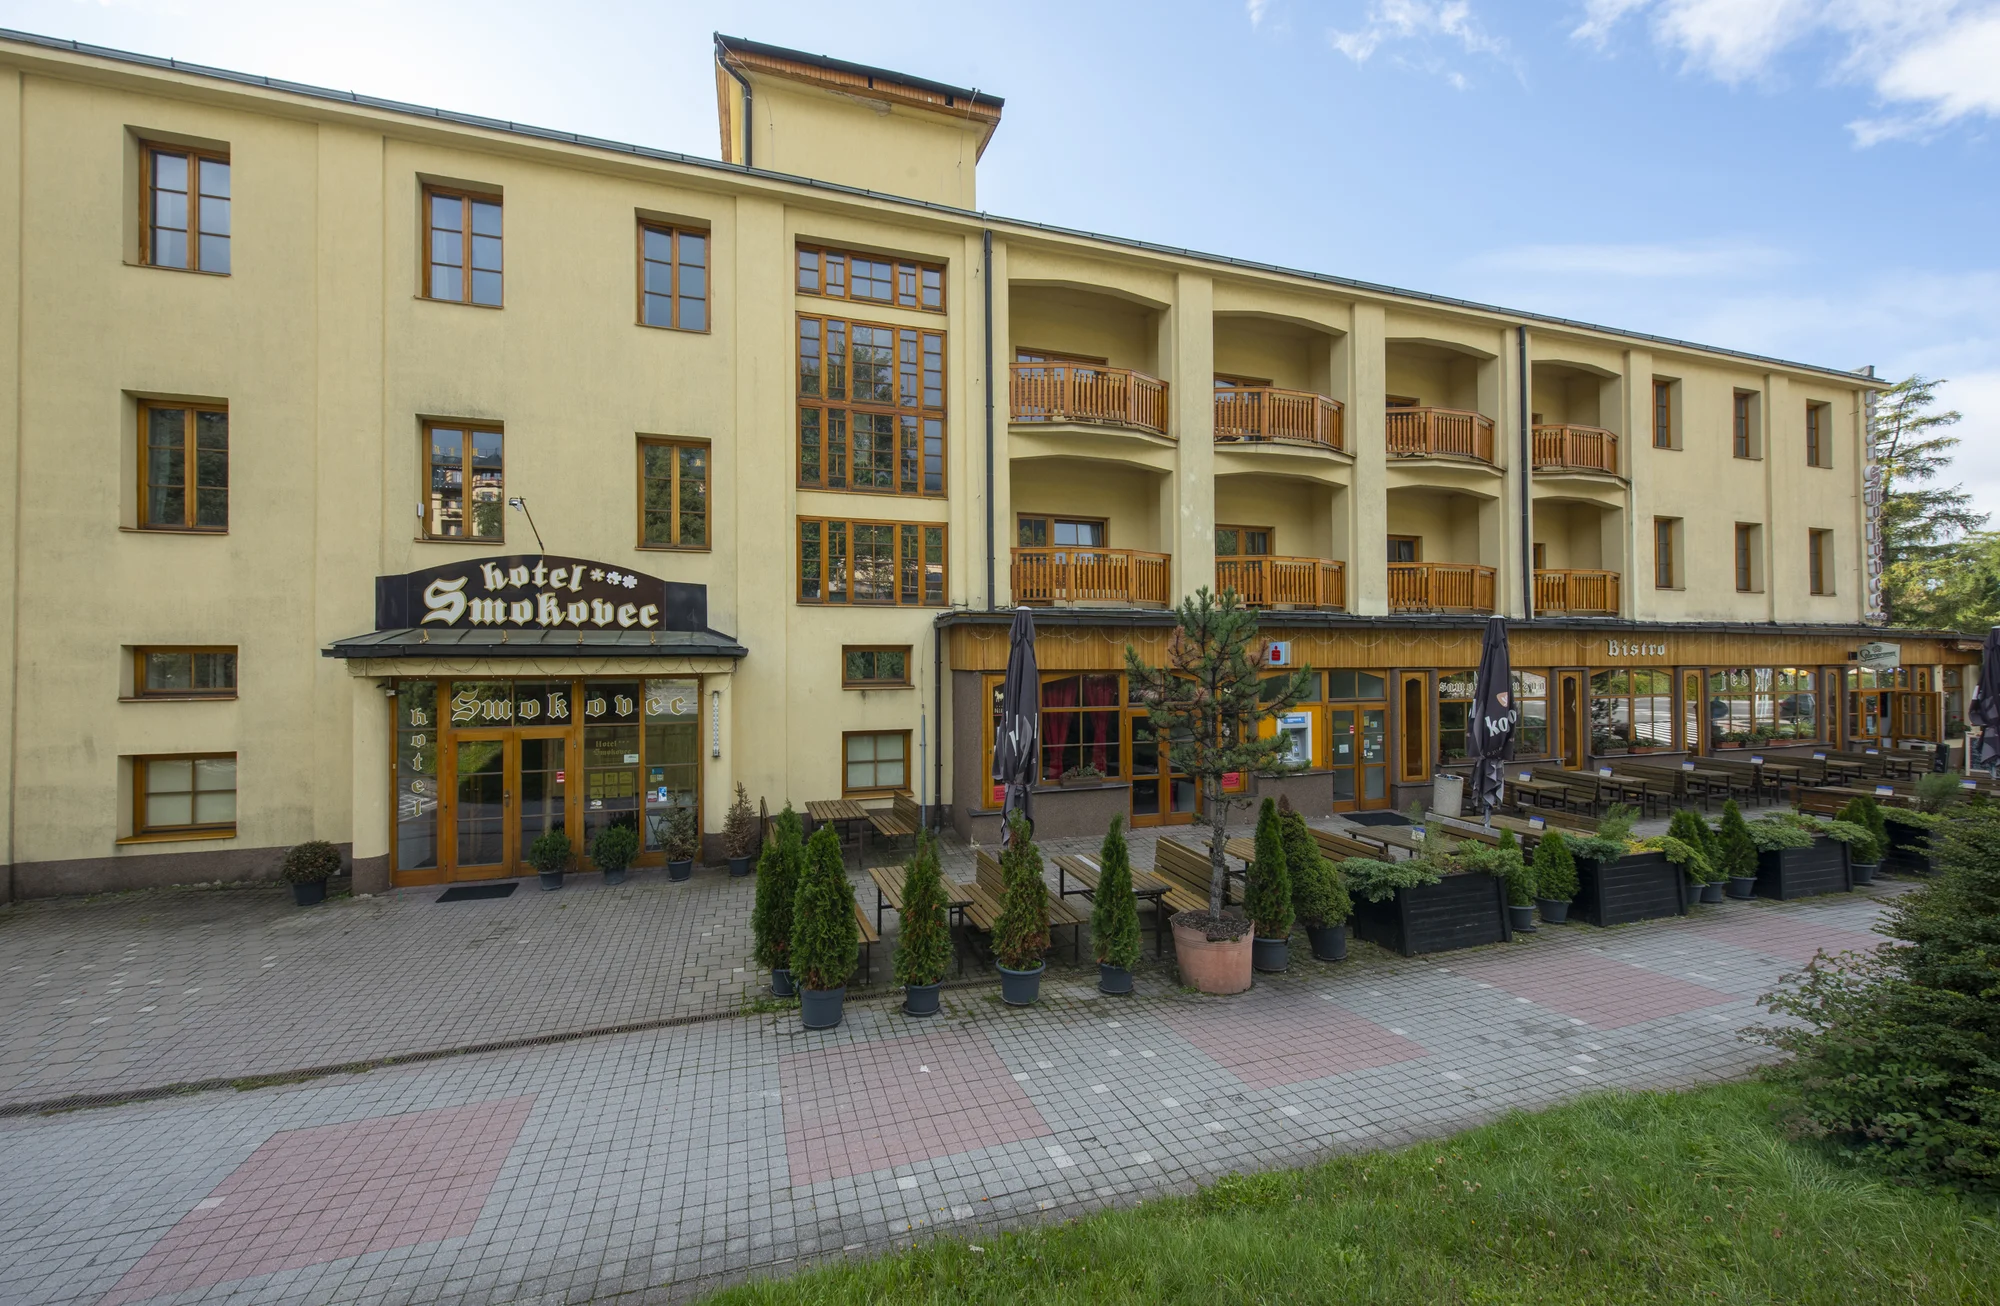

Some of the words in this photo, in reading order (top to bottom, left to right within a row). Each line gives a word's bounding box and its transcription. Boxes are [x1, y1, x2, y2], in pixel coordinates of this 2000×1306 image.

[480, 560, 587, 593] hotel
[420, 575, 659, 629] Smokovec
[1607, 639, 1666, 657] Bistro
[451, 688, 688, 722] Smokovec
[410, 707, 428, 818] hotel
